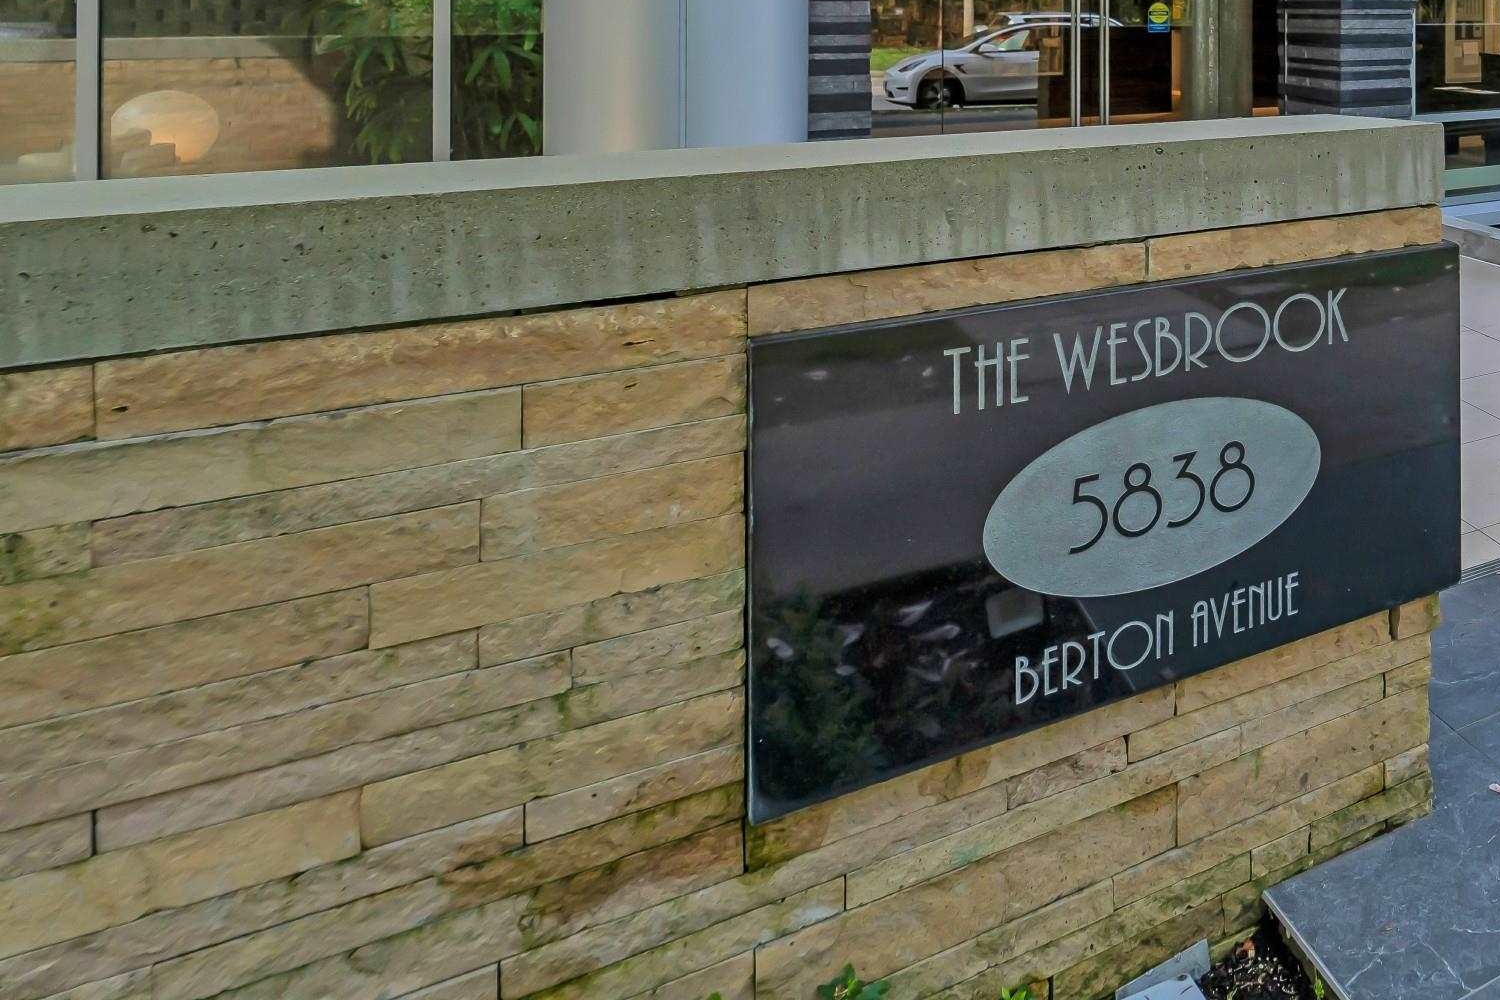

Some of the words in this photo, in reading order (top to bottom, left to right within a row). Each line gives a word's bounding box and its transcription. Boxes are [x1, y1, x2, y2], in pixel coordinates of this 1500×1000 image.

[944, 337, 1028, 414] THE
[1054, 288, 1350, 394] WESBROOK
[1068, 440, 1255, 554] 5838
[1013, 609, 1174, 705] BERTON
[1190, 571, 1300, 647] AVENUE
